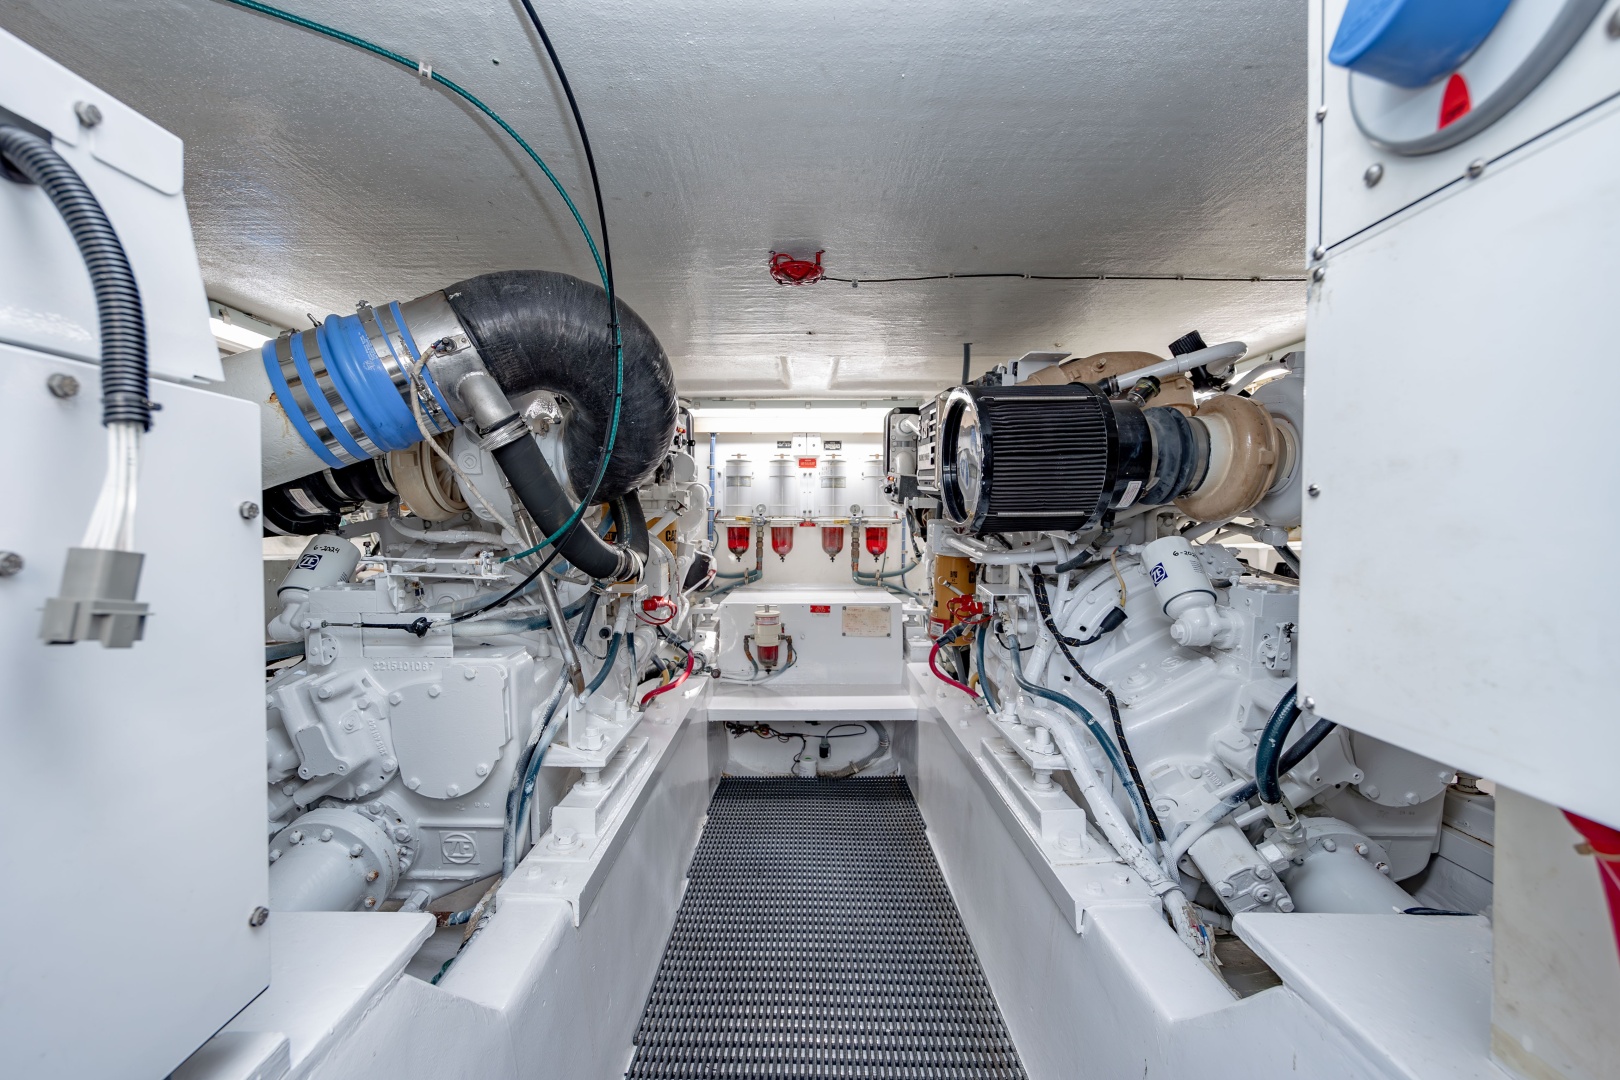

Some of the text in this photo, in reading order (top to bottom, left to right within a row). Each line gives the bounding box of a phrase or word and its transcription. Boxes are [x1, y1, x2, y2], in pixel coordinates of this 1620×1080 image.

[666, 530, 677, 541] CA
[299, 554, 319, 568] ZF
[1151, 565, 1166, 583] ZF
